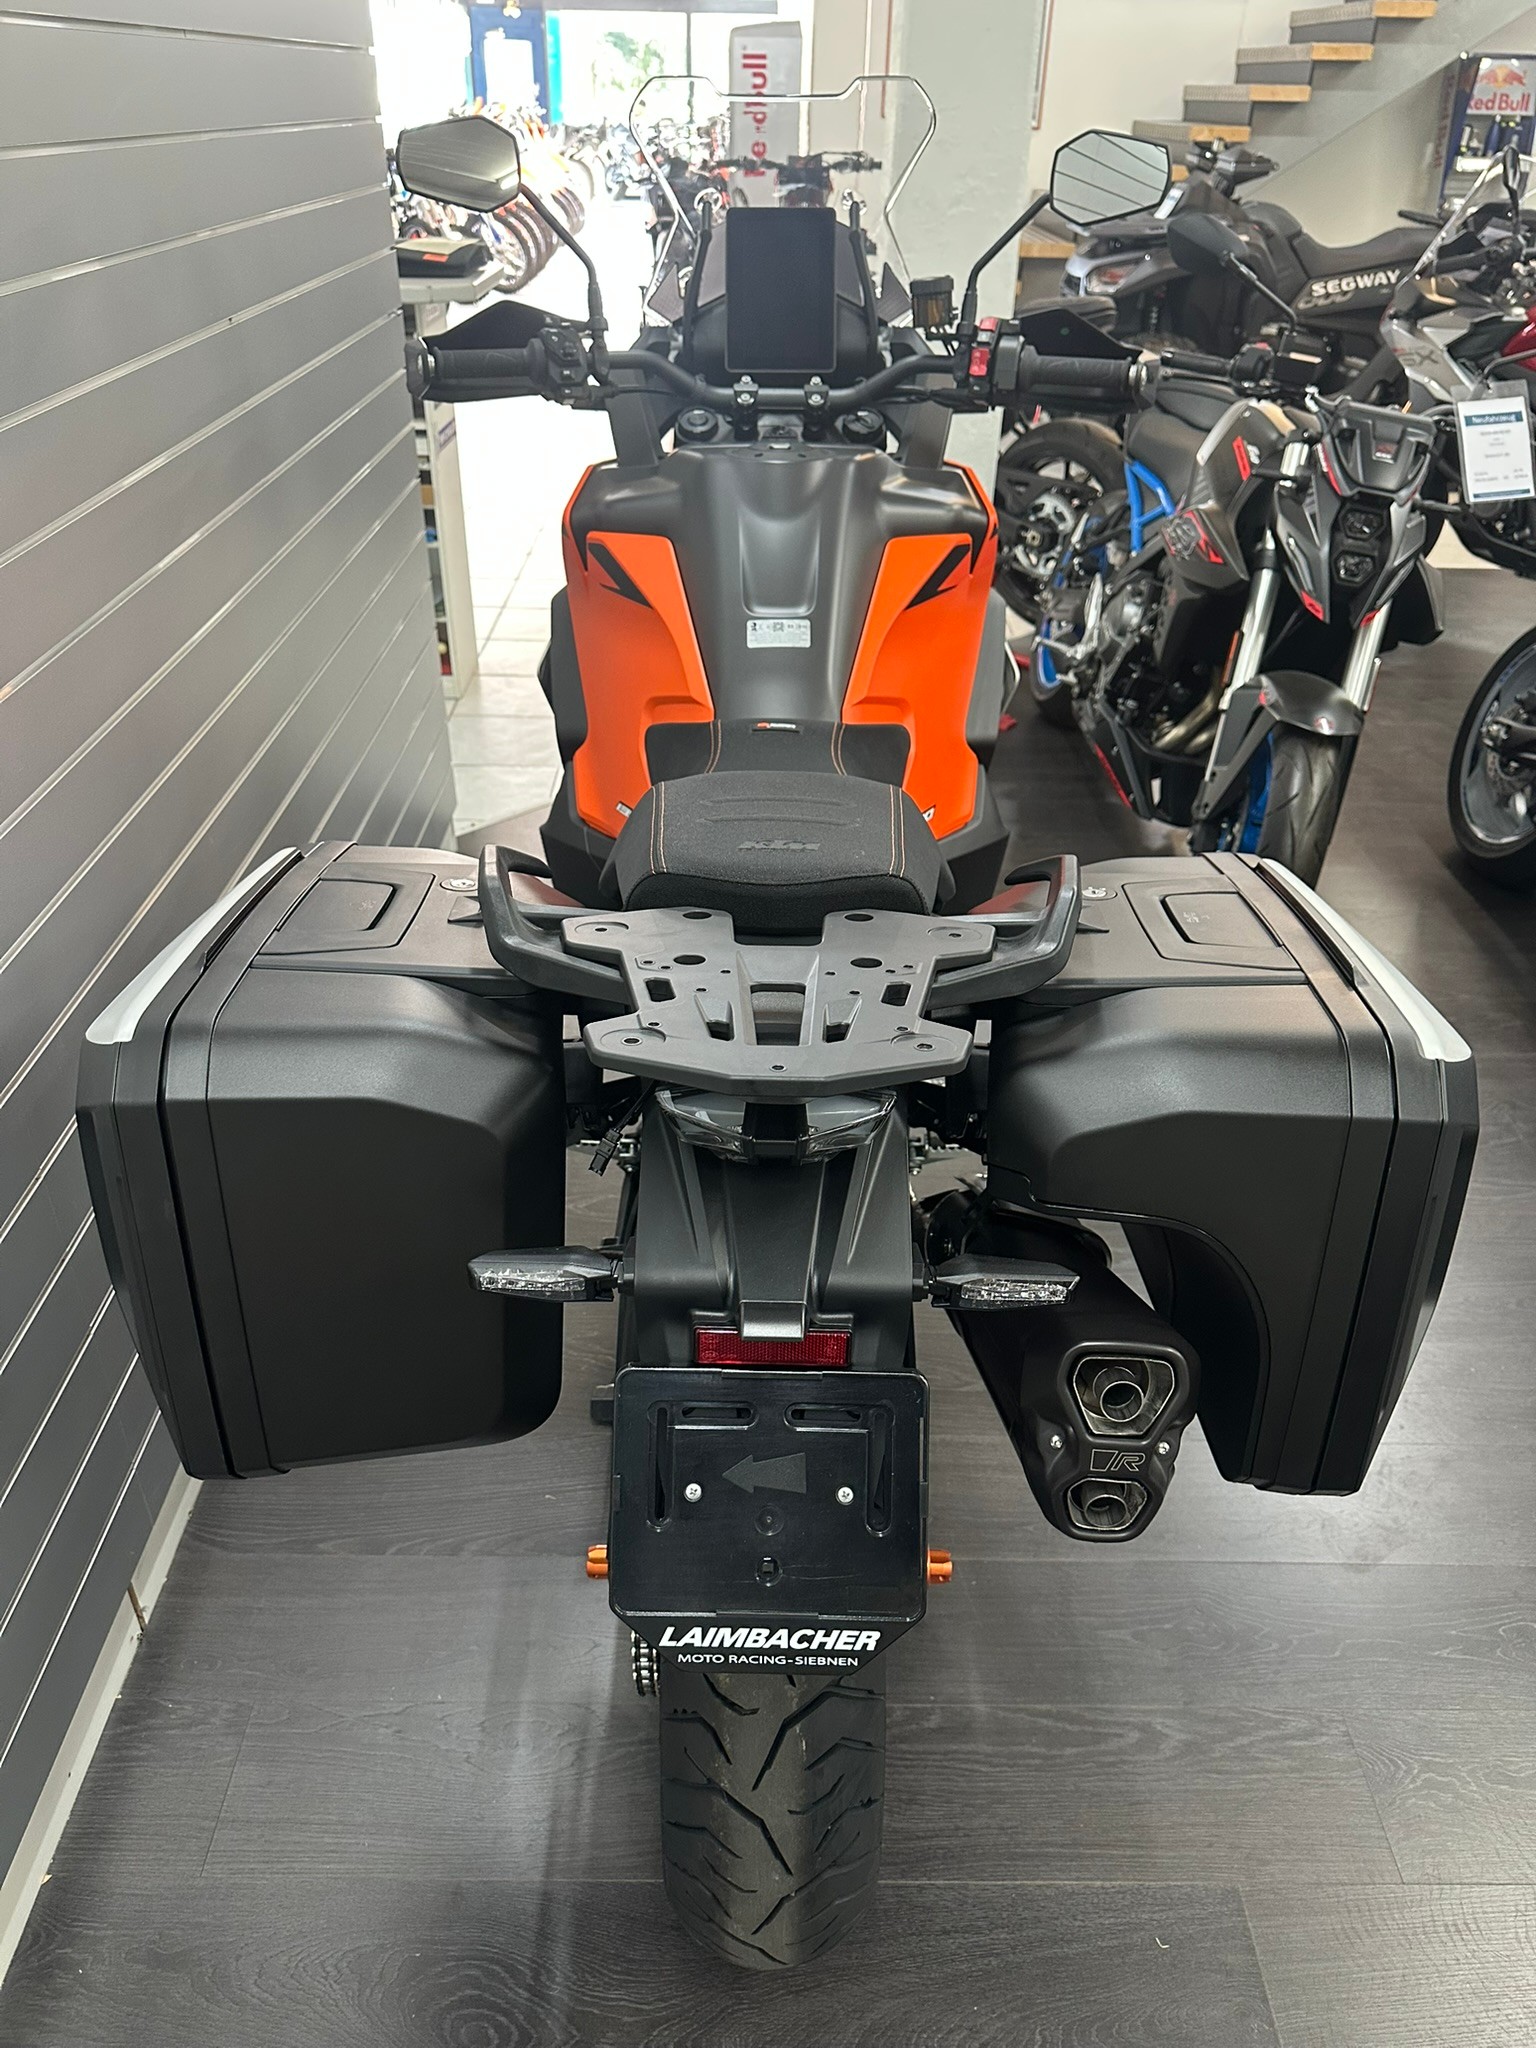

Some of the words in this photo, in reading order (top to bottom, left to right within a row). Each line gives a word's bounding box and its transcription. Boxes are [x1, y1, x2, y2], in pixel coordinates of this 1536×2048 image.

[1498, 92, 1531, 112] Bull
[1312, 269, 1401, 297] SEGWAY
[658, 1626, 881, 1651] LAIMBACHER
[677, 1654, 725, 1664] MOTO
[729, 1655, 859, 1667] RACING-SIEBNEN
